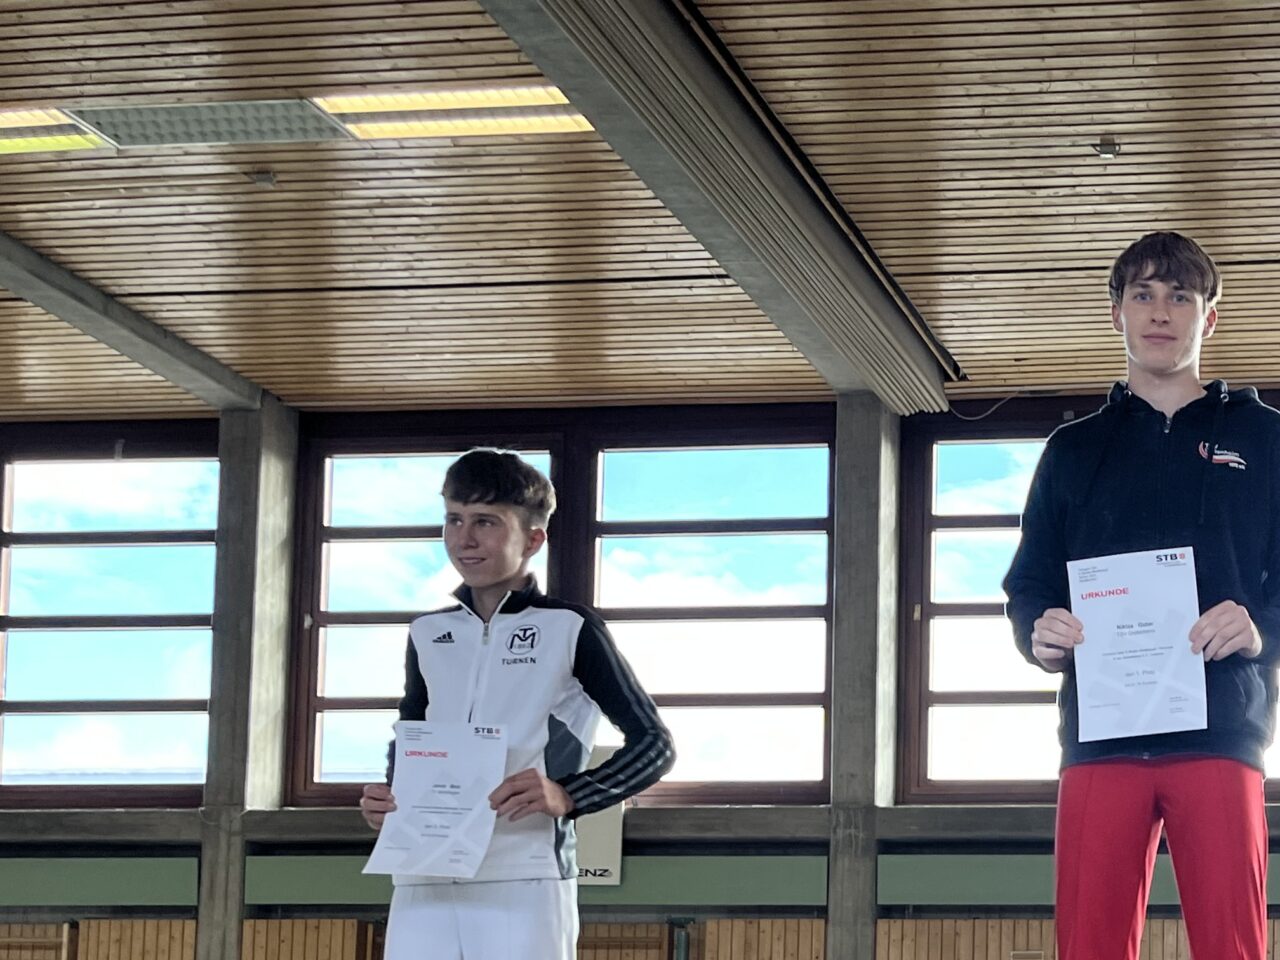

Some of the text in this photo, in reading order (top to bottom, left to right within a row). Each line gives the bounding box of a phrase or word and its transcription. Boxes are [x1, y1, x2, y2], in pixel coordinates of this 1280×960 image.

[1156, 553, 1178, 562] STB
[1081, 587, 1129, 600] URKUNDE
[501, 656, 537, 666] TURNEN
[474, 726, 494, 734] STB
[578, 868, 610, 877] ENZ
